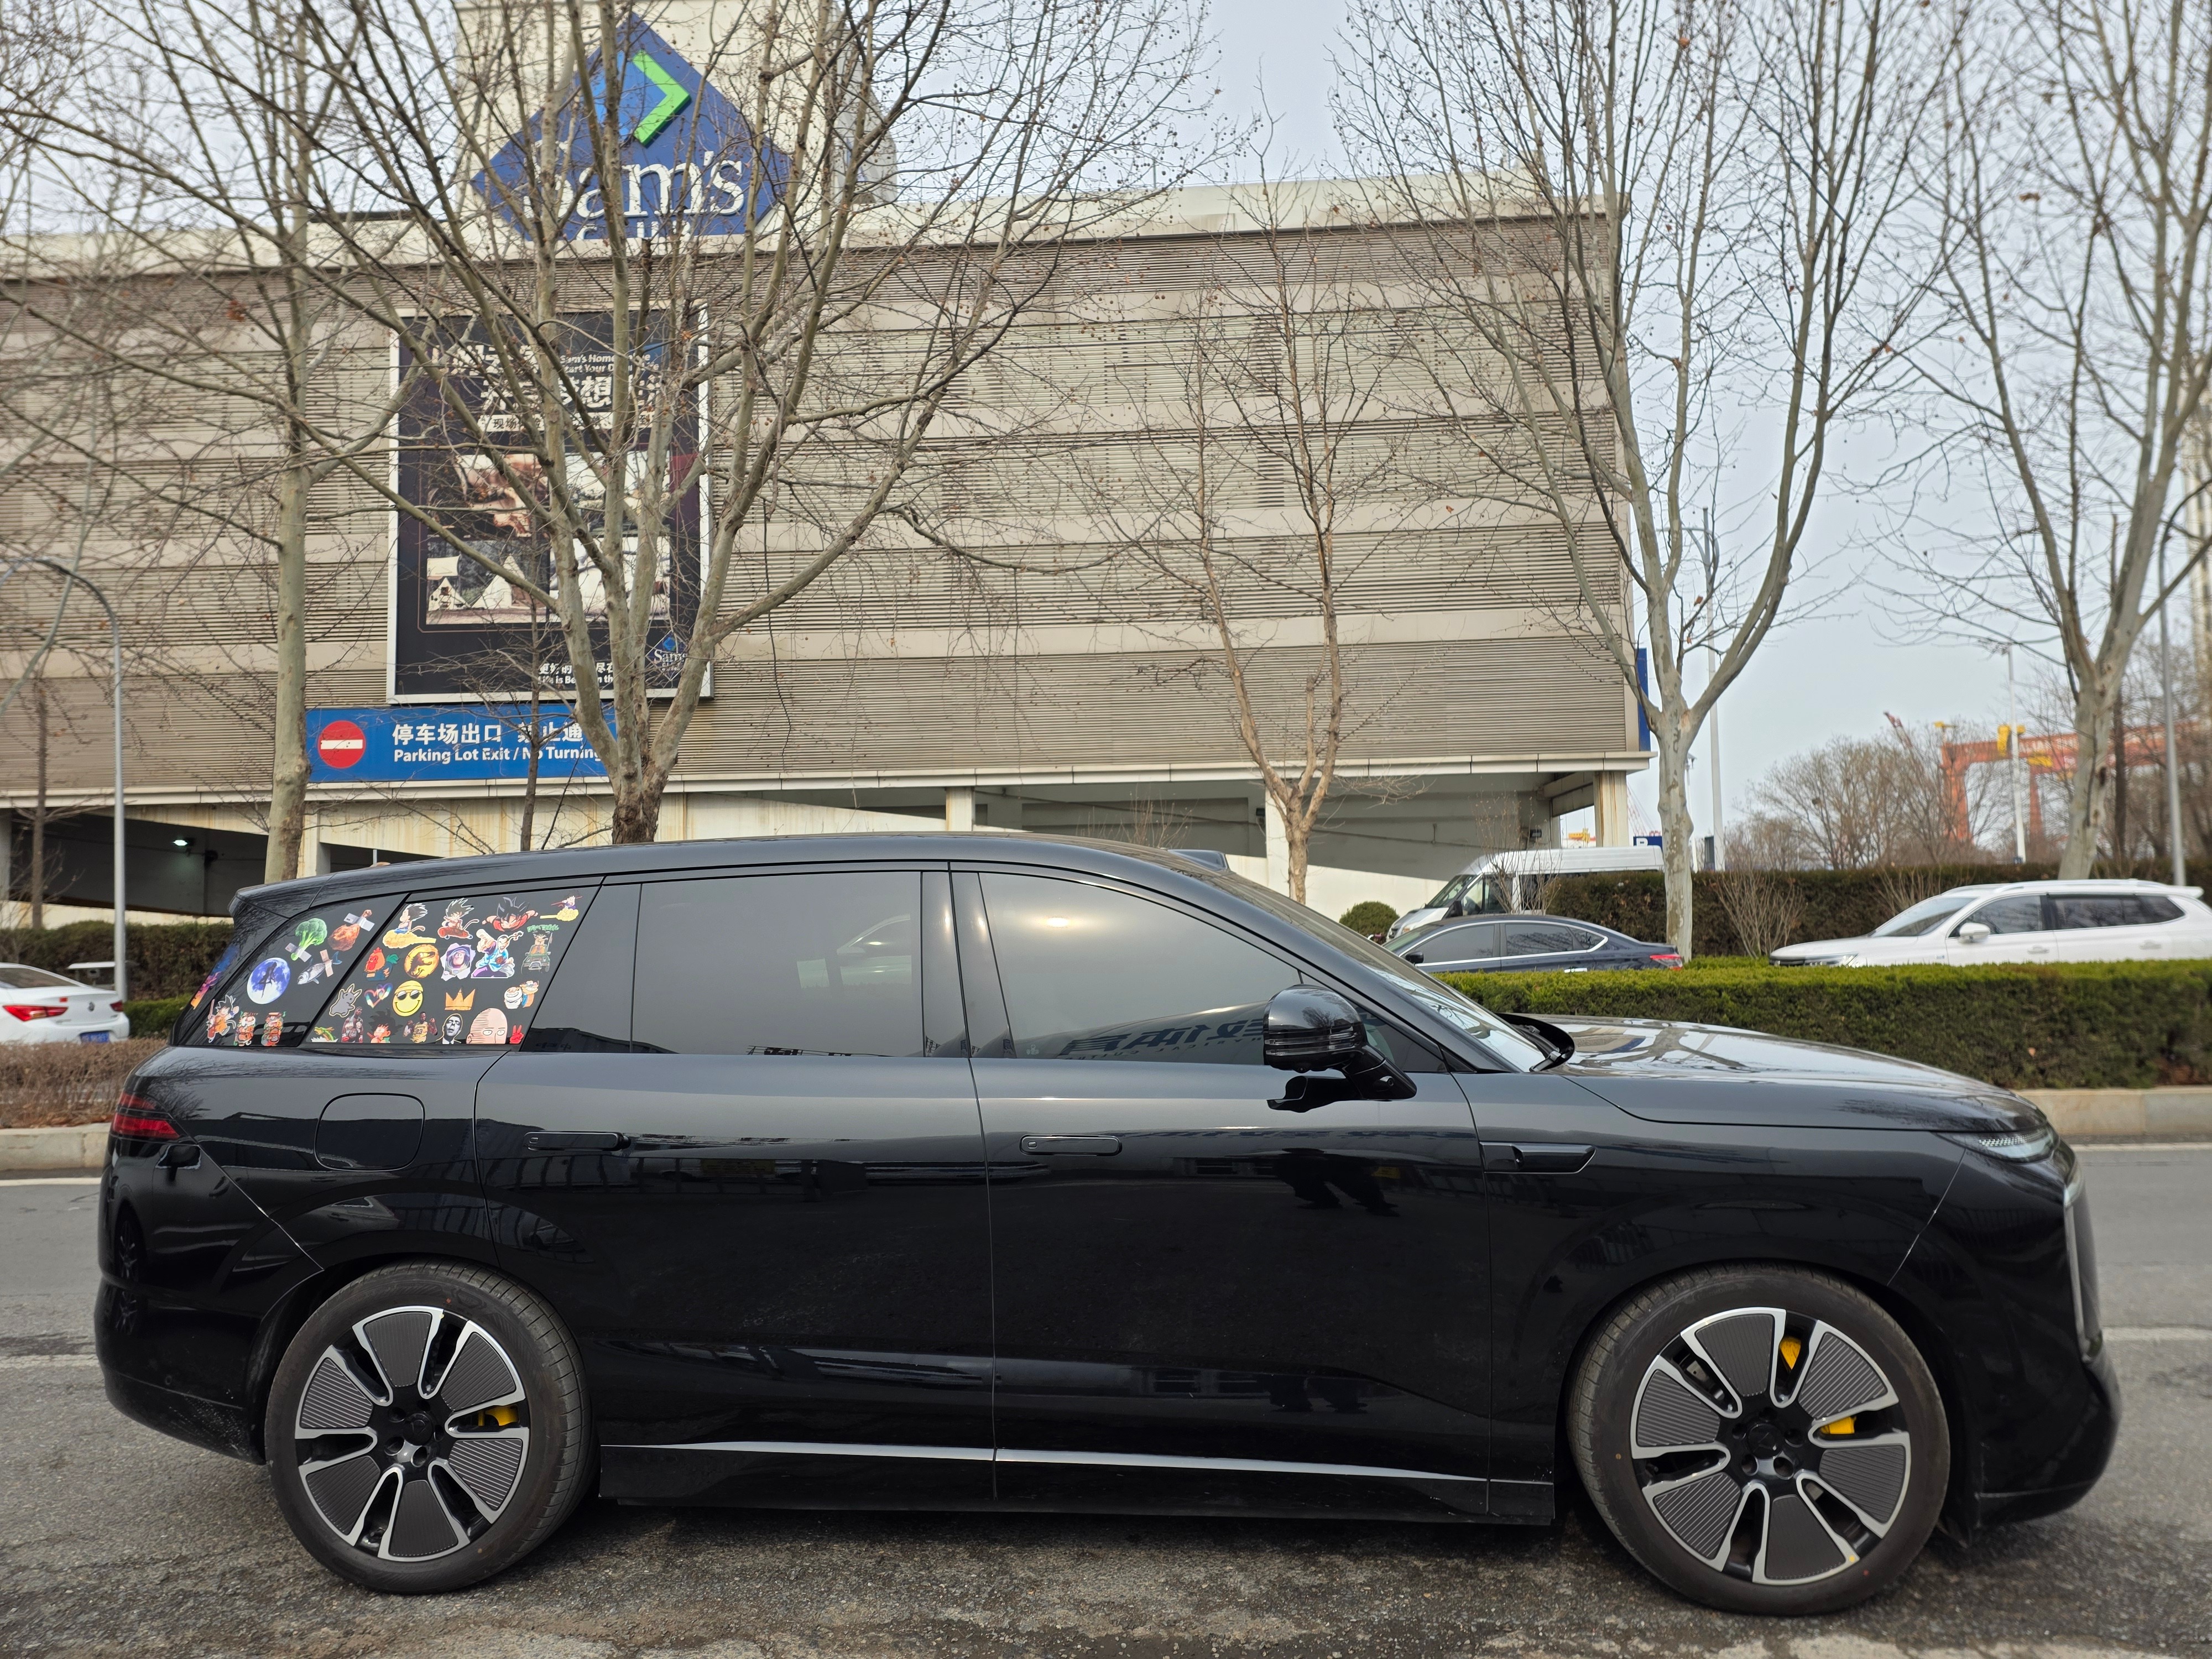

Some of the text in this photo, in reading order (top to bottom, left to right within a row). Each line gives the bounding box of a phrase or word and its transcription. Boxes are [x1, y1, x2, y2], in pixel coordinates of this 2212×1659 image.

[583, 364, 606, 372] Your
[555, 675, 564, 684] is
[392, 723, 501, 745] 停车场出口
[394, 748, 451, 764] Parking
[455, 748, 479, 761] Lot
[482, 747, 510, 761] Exit
